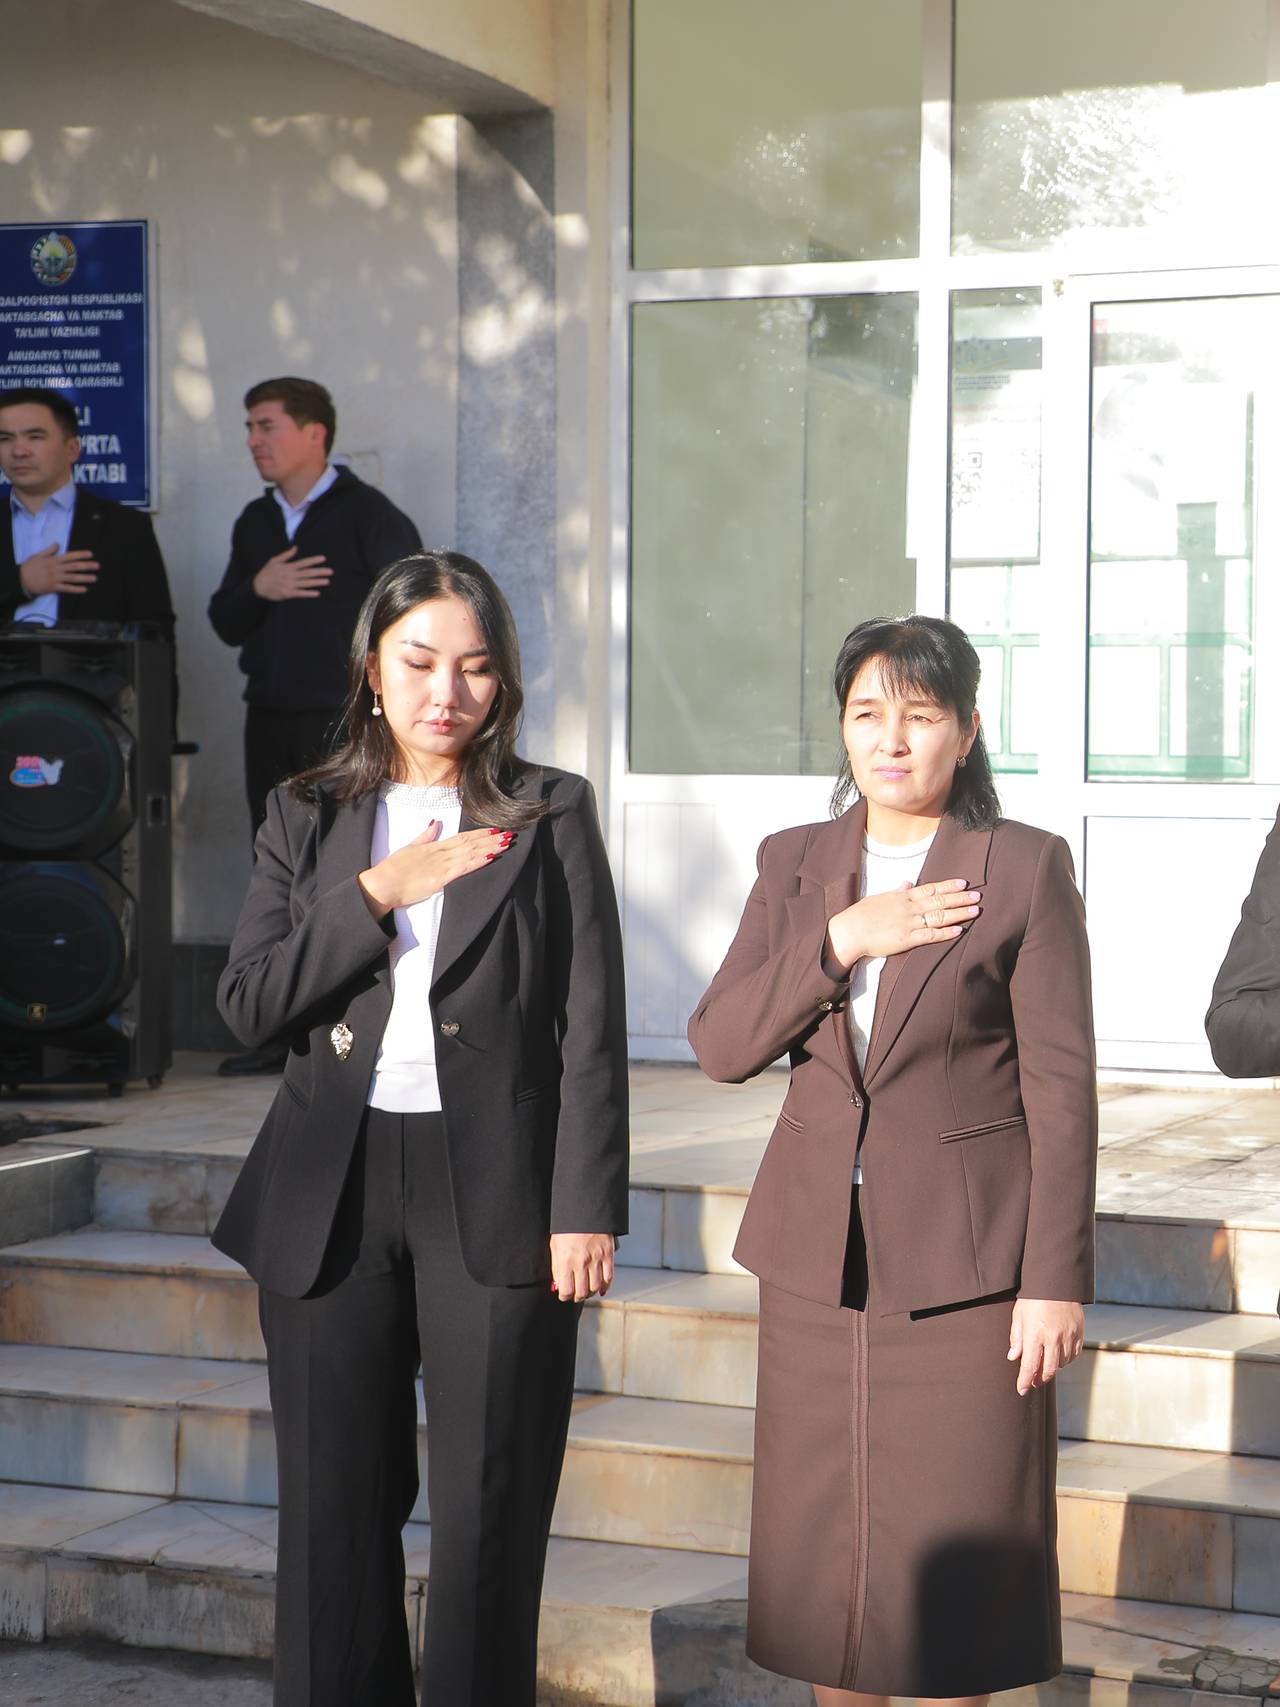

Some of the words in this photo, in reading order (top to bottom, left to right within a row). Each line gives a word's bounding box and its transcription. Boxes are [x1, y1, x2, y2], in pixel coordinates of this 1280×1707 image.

[71, 293, 143, 305] RESPUBLIKASI
[66, 310, 81, 321] VA
[81, 309, 125, 320] MAKTAB
[51, 326, 100, 337] VAZIRLIGI
[8, 350, 61, 361] AMUDARYO
[62, 349, 100, 360] TUMANI
[64, 363, 79, 373] VA
[80, 362, 121, 373] MAKTAB
[74, 376, 124, 387] QARASHLI
[73, 462, 127, 484] KTABI
